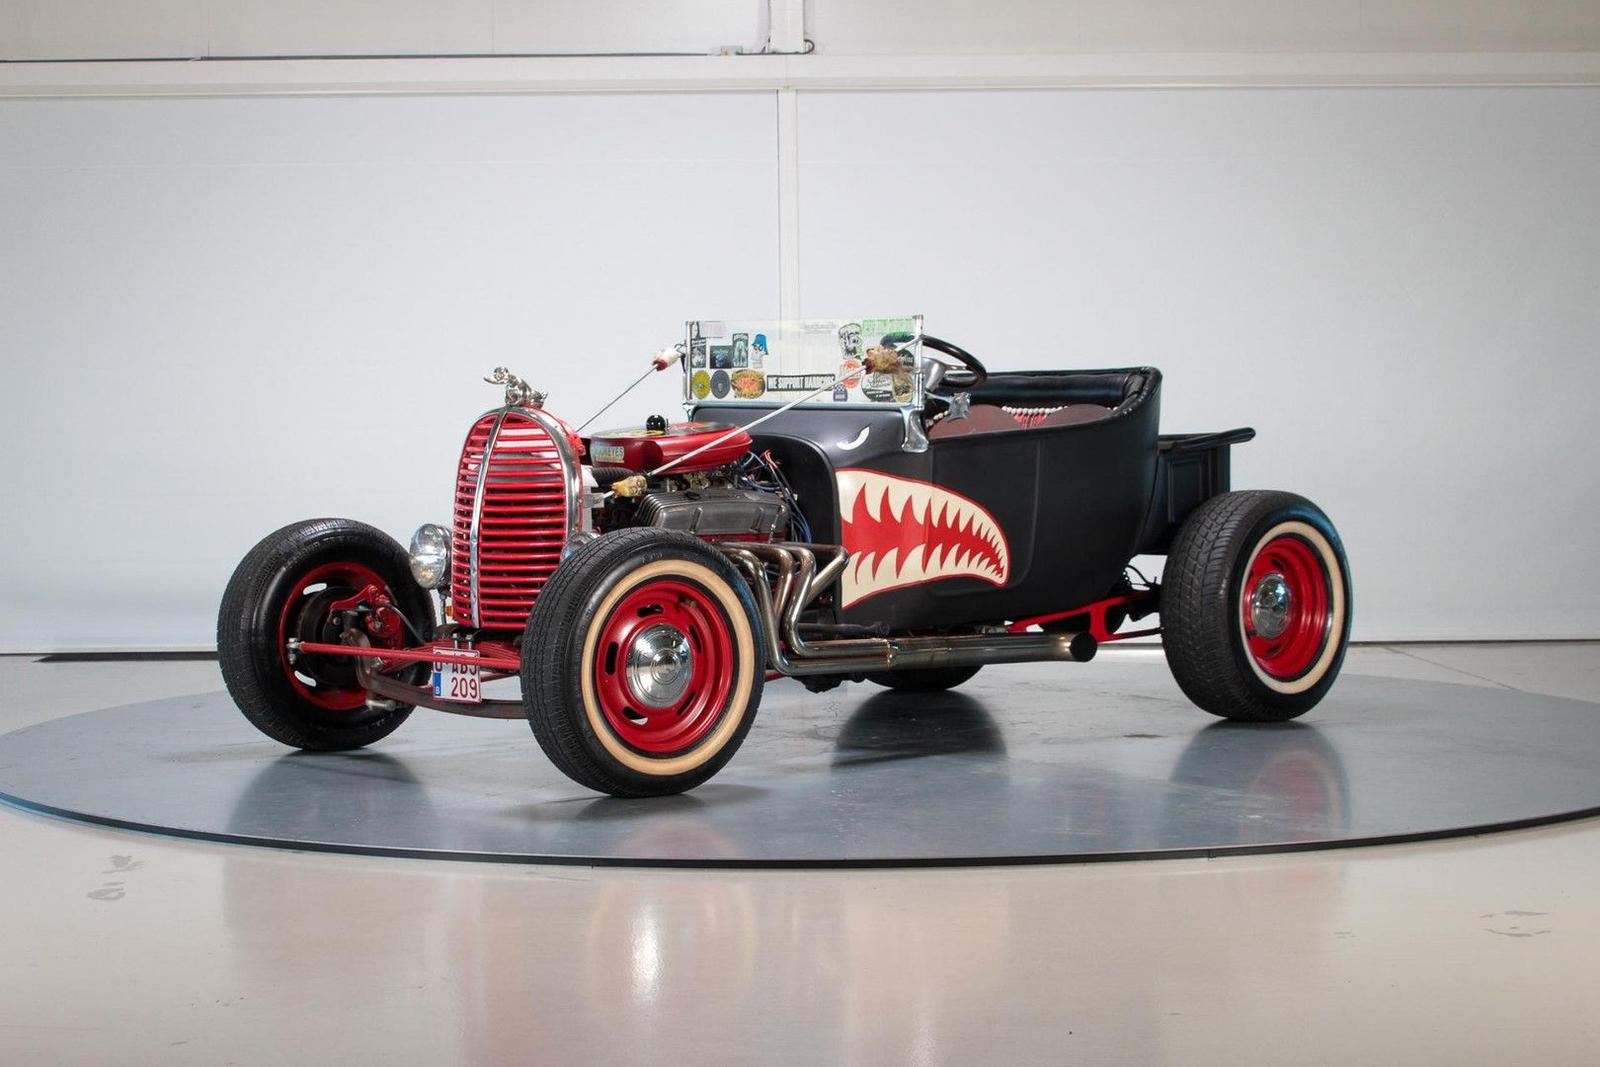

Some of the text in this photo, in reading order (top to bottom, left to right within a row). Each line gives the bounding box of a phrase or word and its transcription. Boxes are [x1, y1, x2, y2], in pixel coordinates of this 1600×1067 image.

[768, 376, 777, 389] WE
[778, 376, 804, 389] SUPPORT
[435, 686, 440, 694] B
[451, 677, 477, 698] 209
